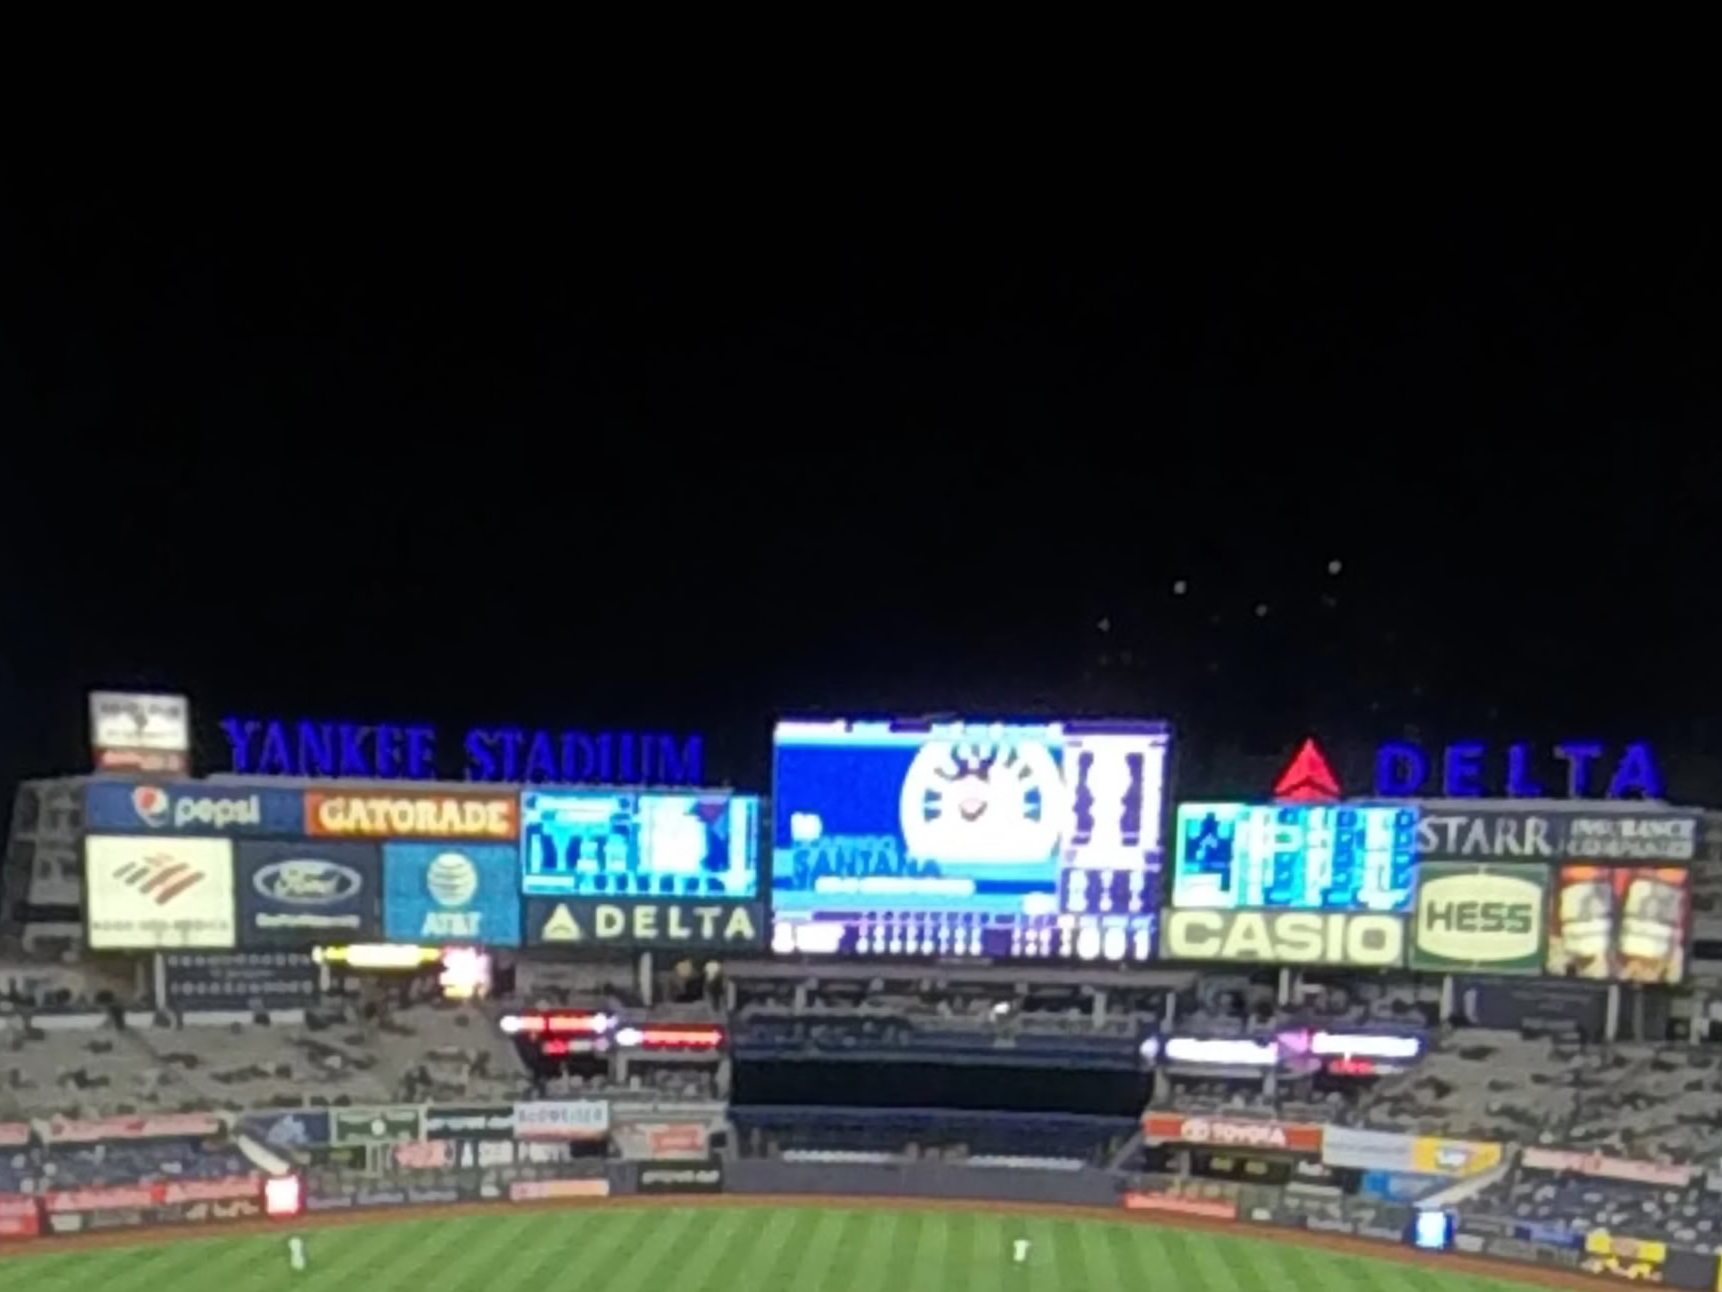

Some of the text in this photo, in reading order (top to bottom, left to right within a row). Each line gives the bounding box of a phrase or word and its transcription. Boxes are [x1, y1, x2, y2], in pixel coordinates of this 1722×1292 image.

[220, 715, 705, 782] YANKEE STADIUM
[1376, 738, 1665, 799] DELTA
[174, 795, 260, 828] pepsi
[319, 798, 511, 834] GATORADE
[1420, 816, 1553, 856] STARR
[421, 912, 482, 935] AT&T
[595, 905, 756, 939] DELTA
[1425, 901, 1533, 934] HESS
[1166, 912, 1404, 962] CASIO
[1213, 1122, 1286, 1146] TOYOTA
